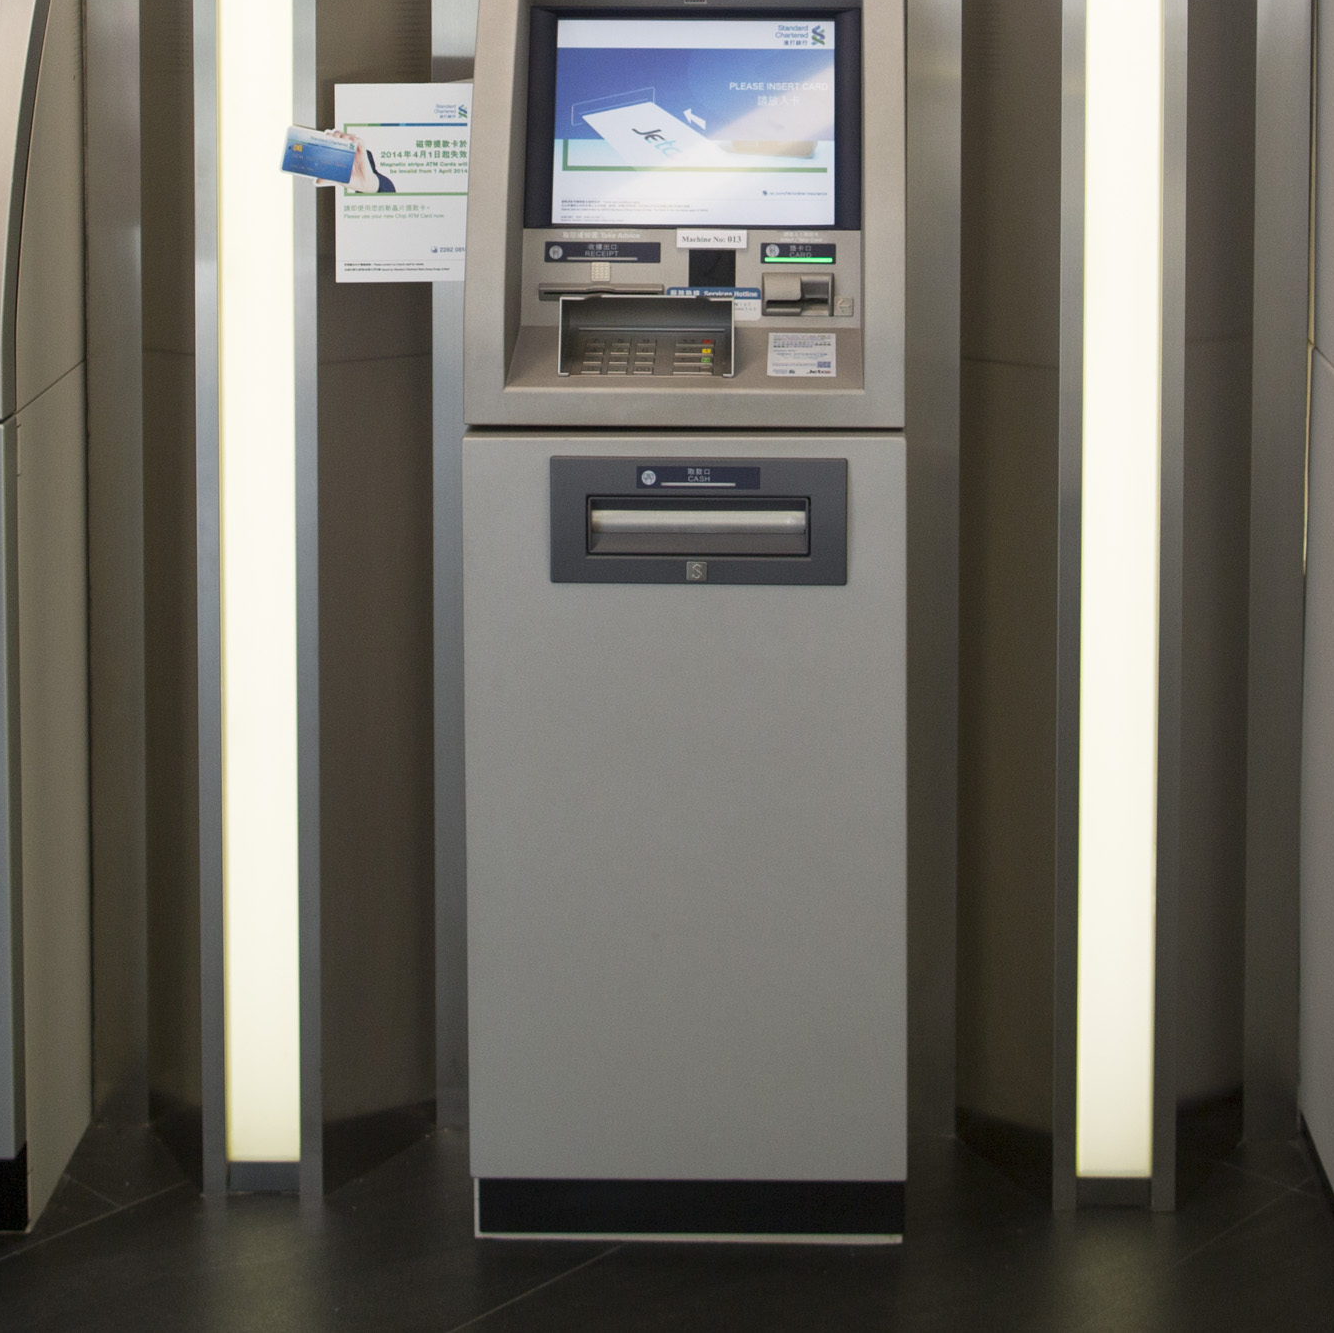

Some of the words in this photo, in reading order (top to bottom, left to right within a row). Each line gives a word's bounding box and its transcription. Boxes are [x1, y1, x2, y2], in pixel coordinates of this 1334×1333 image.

[778, 24, 809, 32] Standard
[729, 81, 765, 91] PLEASE
[767, 81, 800, 91] INSERT
[801, 81, 829, 91] CARD
[681, 234, 710, 243] Machine
[727, 235, 742, 244] 013
[687, 475, 711, 483] CASH
